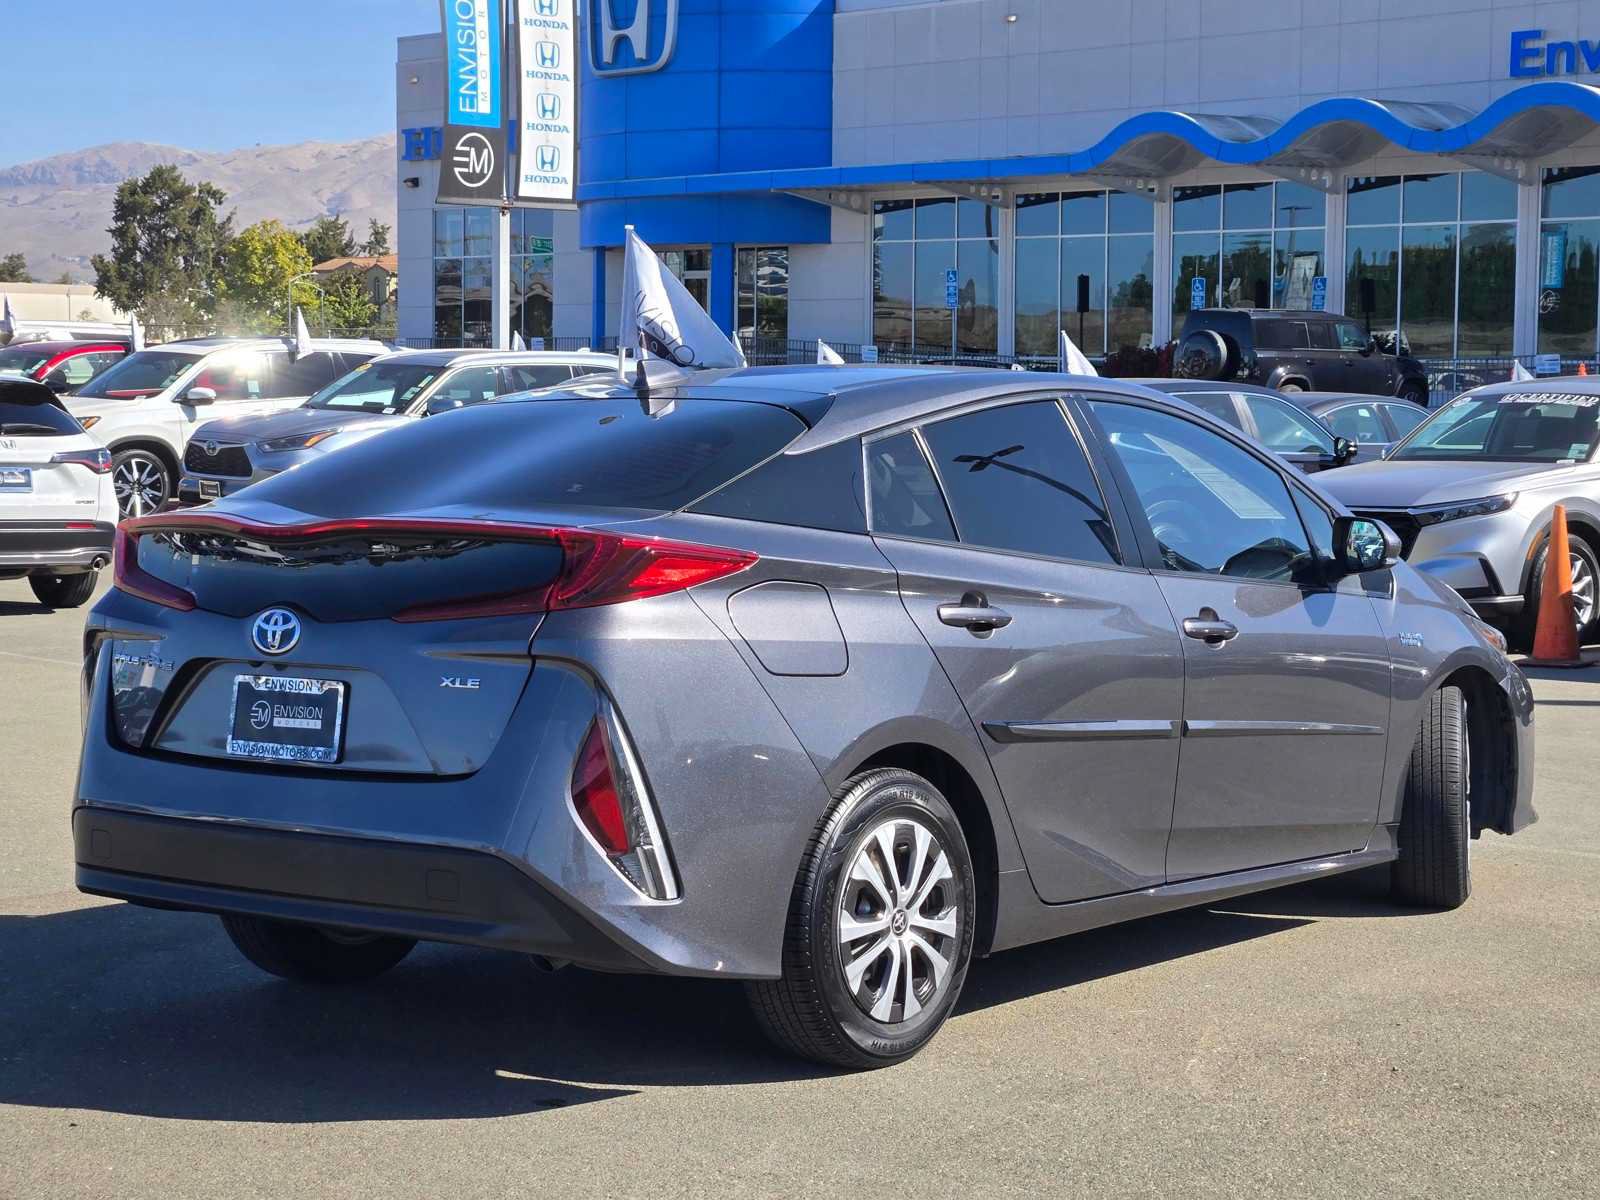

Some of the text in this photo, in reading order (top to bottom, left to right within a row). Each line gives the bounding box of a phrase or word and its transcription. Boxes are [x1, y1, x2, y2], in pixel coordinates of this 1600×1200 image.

[524, 18, 569, 30] HONDA
[526, 70, 571, 82] HONDA
[526, 122, 570, 134] HONDA
[524, 174, 568, 185] HONDA
[1519, 392, 1600, 403] CERTIFIED
[264, 679, 313, 692] ENVISION
[440, 677, 480, 689] XLE
[273, 704, 323, 720] ENVISION
